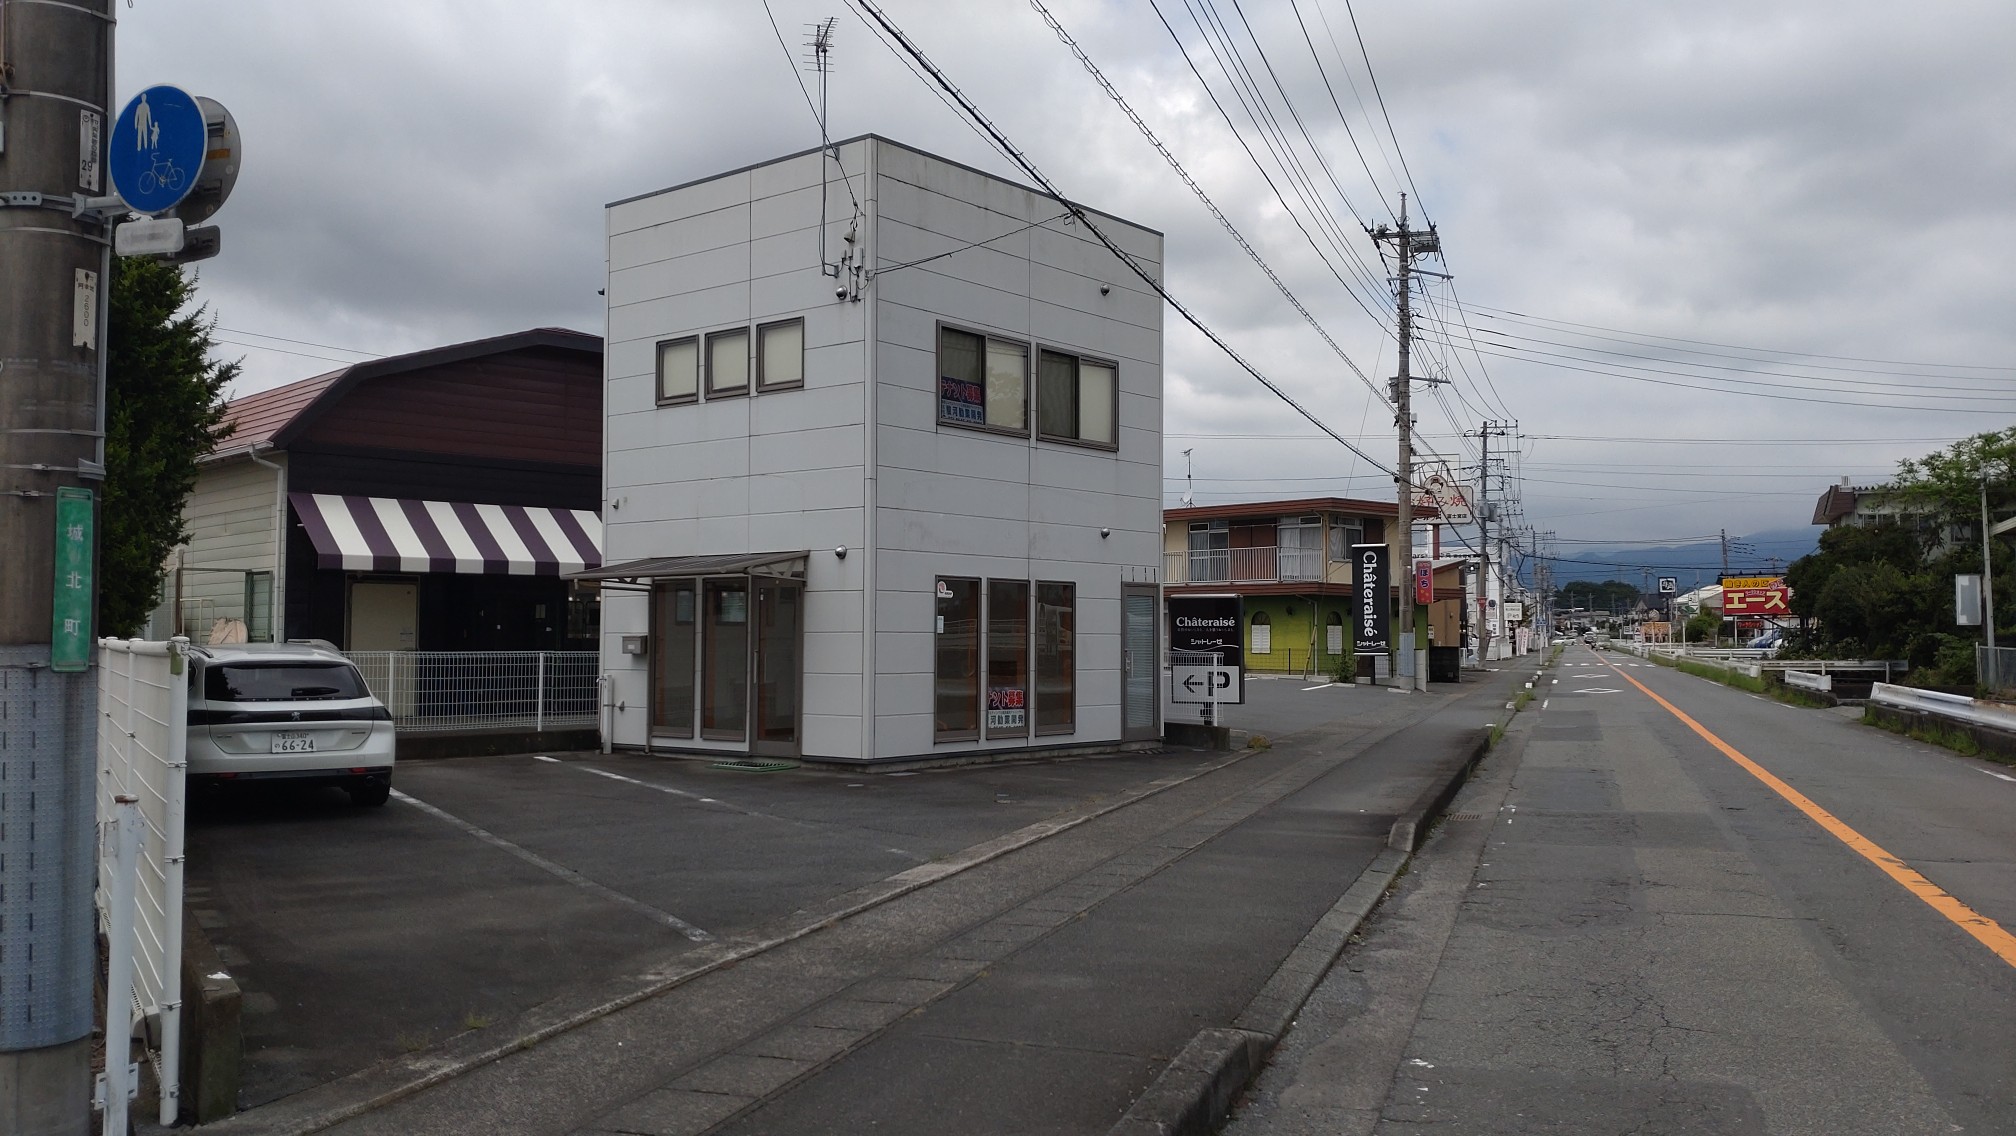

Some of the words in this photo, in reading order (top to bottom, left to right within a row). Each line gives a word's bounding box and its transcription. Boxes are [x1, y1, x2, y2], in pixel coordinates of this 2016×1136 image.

[64, 523, 84, 636] 城北町
[1363, 550, 1378, 637] Châteraisé
[1726, 591, 1786, 609] エース
[1176, 617, 1236, 627] Châteraisé
[1208, 671, 1231, 697] P
[282, 739, 314, 751] 66-24
